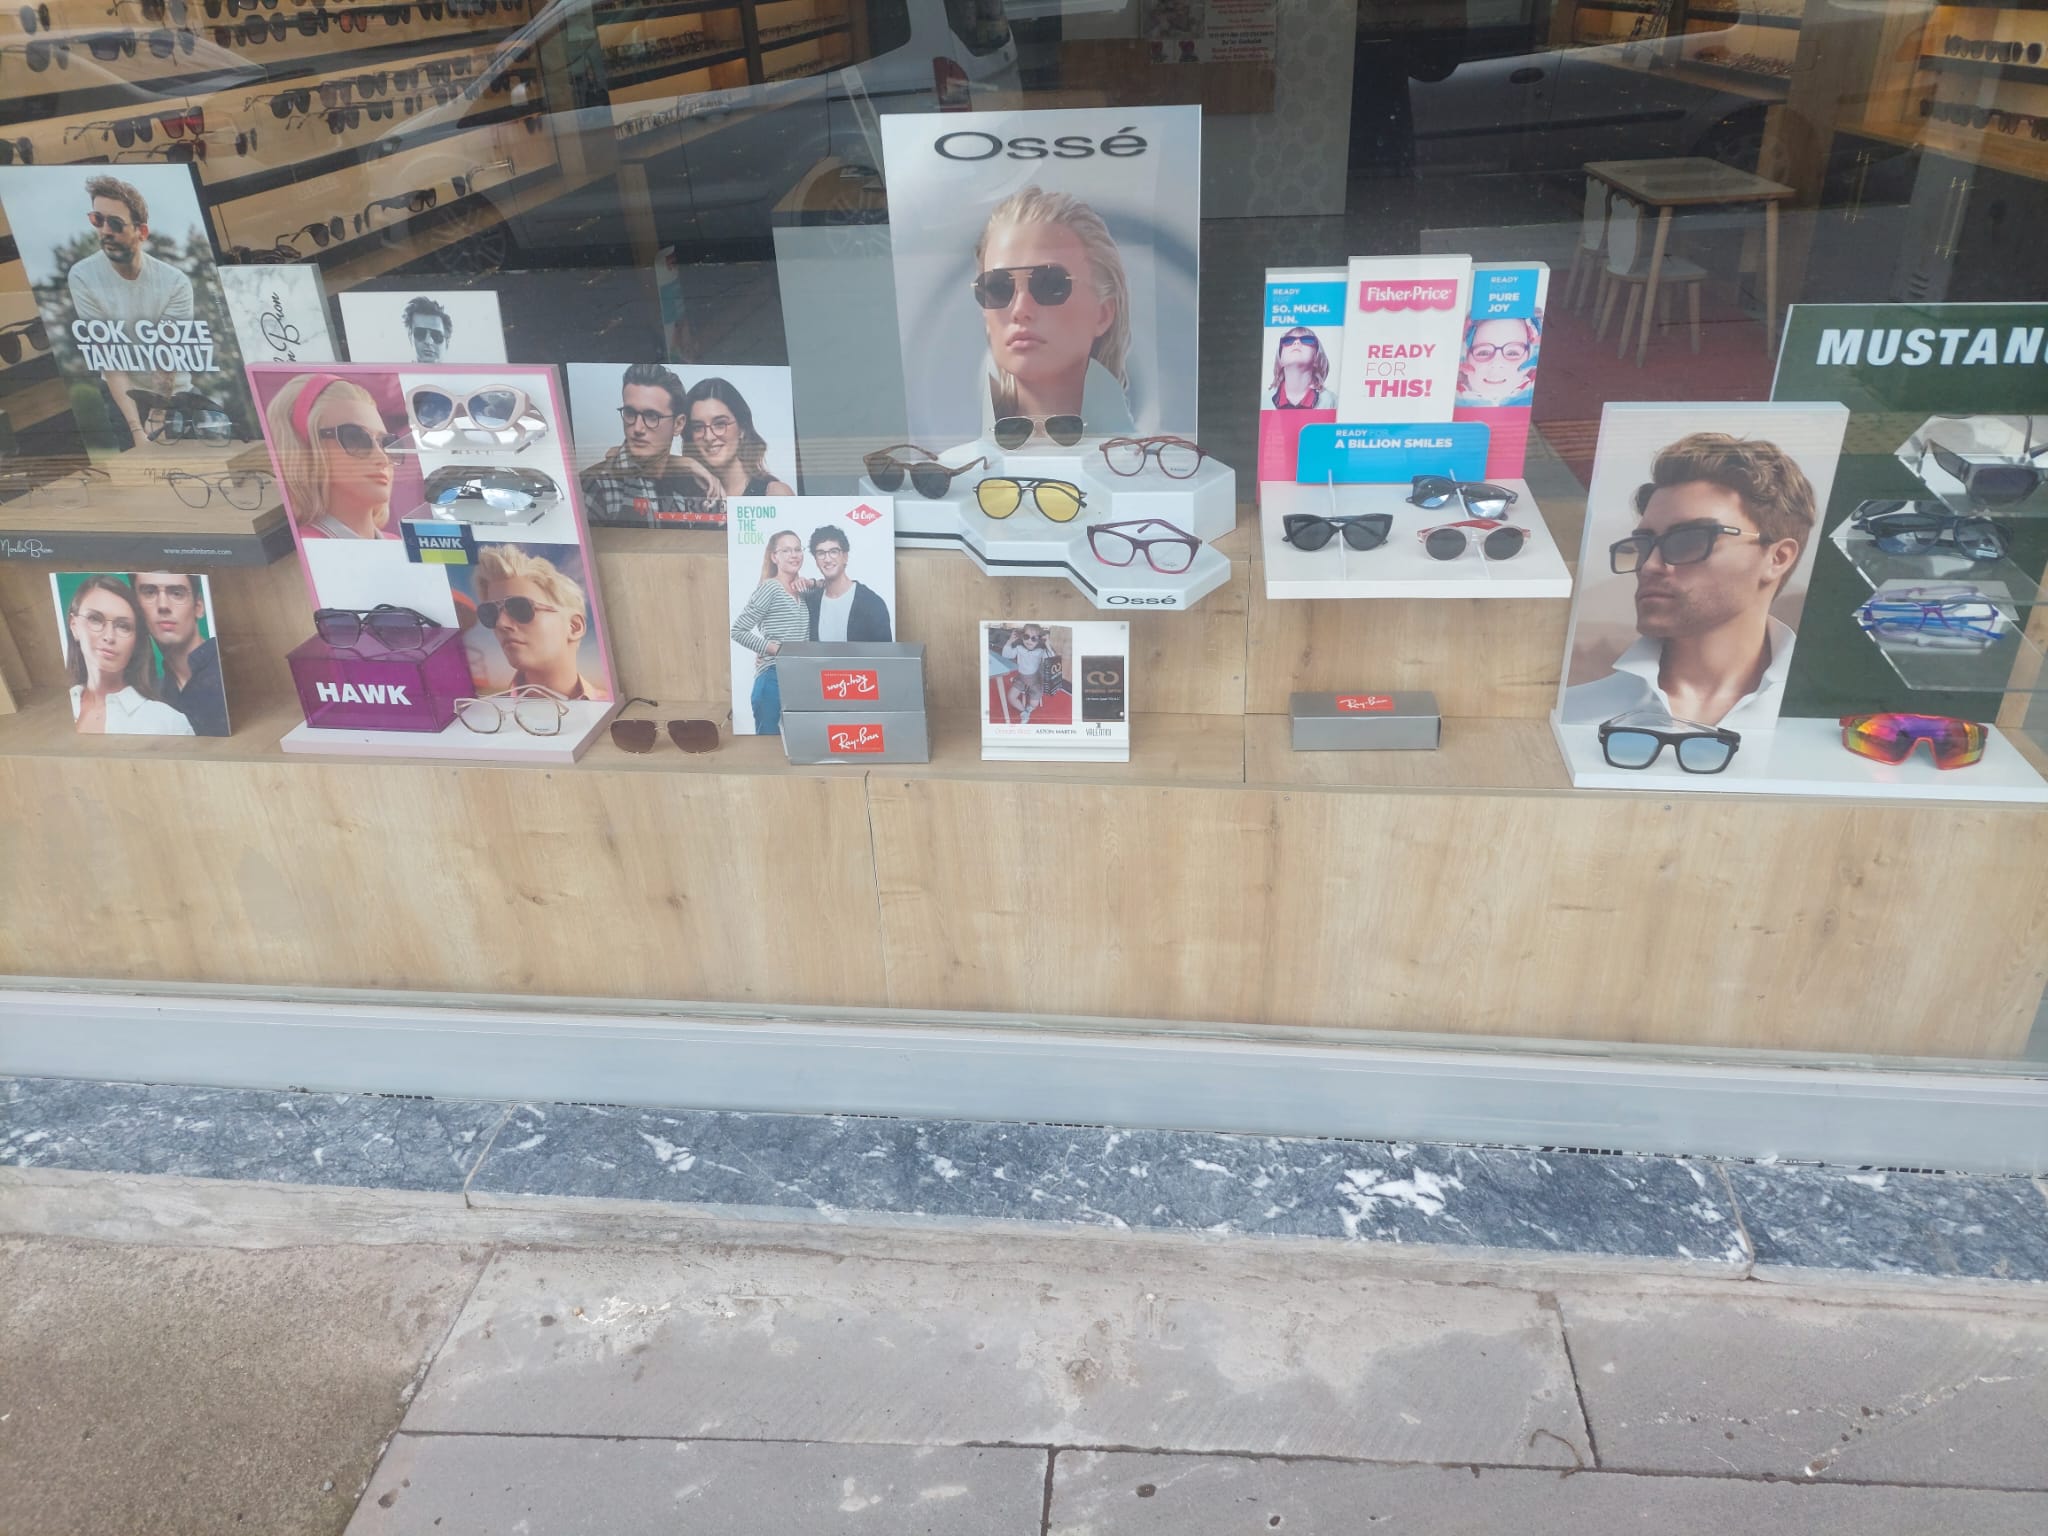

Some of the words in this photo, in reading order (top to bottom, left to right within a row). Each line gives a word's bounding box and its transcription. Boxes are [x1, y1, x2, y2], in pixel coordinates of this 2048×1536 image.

[934, 126, 1148, 162] Ossé
[1488, 292, 1520, 302] PURE
[1271, 304, 1291, 313] SO.
[1293, 304, 1331, 313] MUCH.
[1488, 304, 1510, 313] JOY
[1271, 315, 1298, 324] FUN.
[135, 319, 213, 344] GÖZE
[1367, 344, 1436, 359] READY
[1815, 326, 2048, 366] MUSTAN
[76, 344, 221, 372] TAKILIYORUZ
[1366, 362, 1406, 376] FOR
[1364, 379, 1433, 397] THIS!
[1335, 429, 1368, 437] READY
[1334, 438, 1345, 448] A
[1347, 438, 1401, 448] BILLION
[1404, 438, 1453, 448] SMILES
[736, 505, 777, 519] BEYOND
[738, 519, 757, 532] THE
[418, 537, 463, 549] HAWK
[737, 532, 765, 545] LOOK
[1106, 594, 1177, 606] Ossé
[315, 681, 413, 706] HAWK
